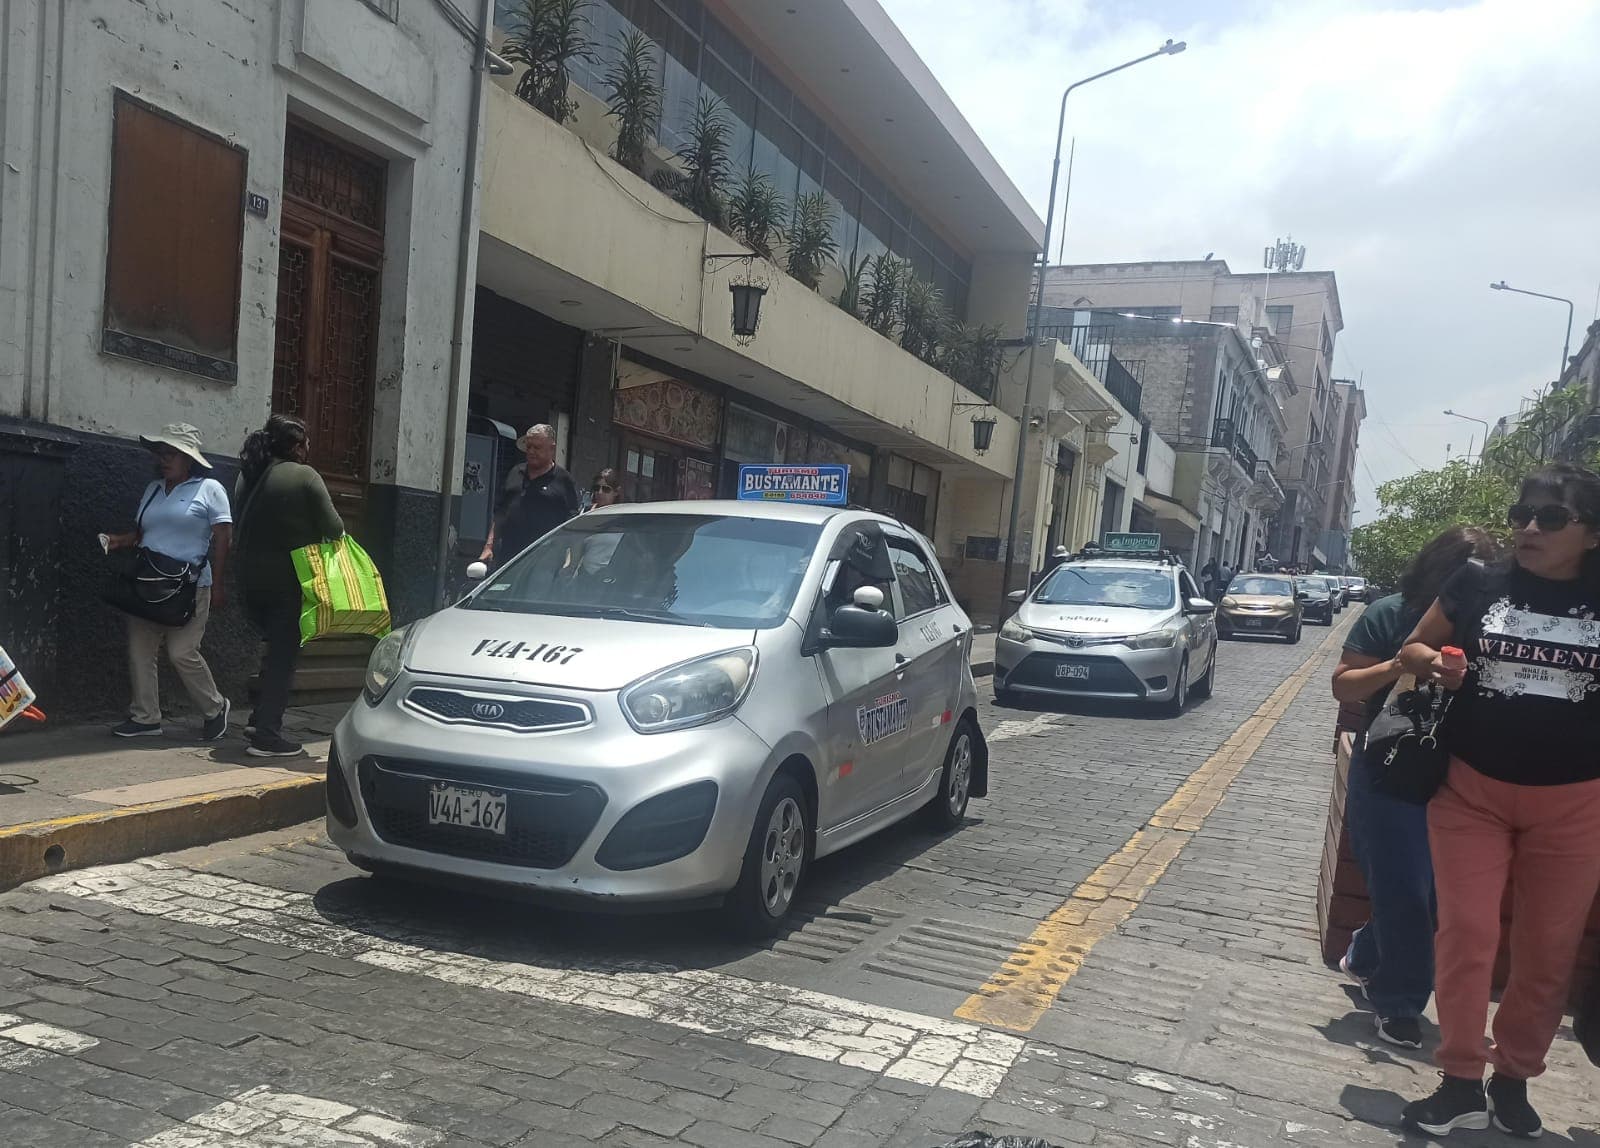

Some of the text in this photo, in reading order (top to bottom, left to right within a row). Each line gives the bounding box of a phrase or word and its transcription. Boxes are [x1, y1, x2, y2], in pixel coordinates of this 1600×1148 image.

[745, 474, 840, 493] BUSTAMANTE
[471, 639, 583, 664] V4A-167
[1514, 672, 1531, 680] YOUR
[1532, 674, 1549, 682] PLAN
[475, 702, 497, 715] KIA
[430, 793, 505, 829] V4A-167
